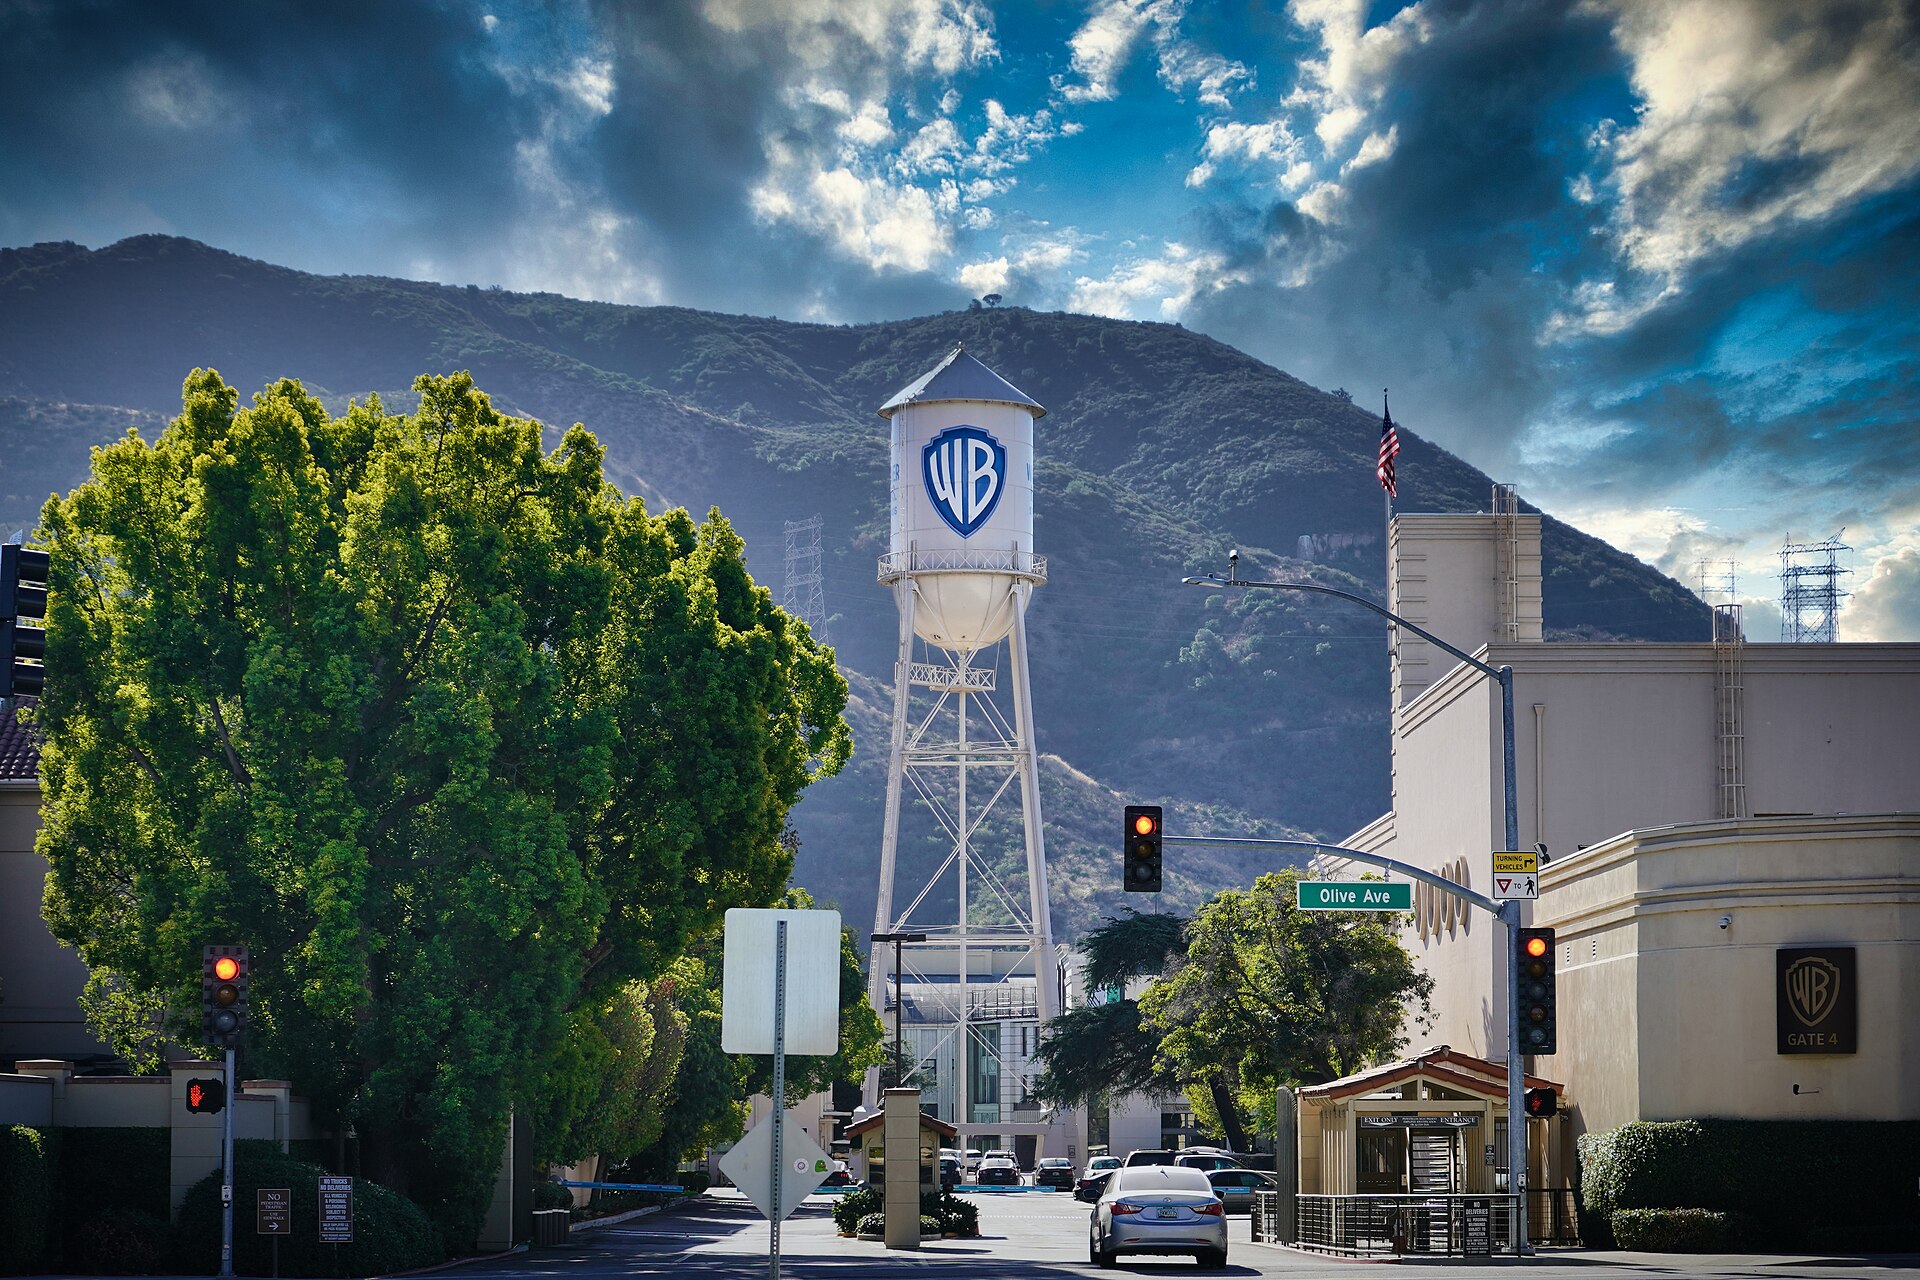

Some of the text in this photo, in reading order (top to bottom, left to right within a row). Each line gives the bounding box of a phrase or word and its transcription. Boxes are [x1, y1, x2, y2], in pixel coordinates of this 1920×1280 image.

[929, 438, 998, 525] WB
[1320, 888, 1391, 904] Olive Ave
[1792, 966, 1830, 1015] WB
[1788, 1033, 1838, 1046] GATE 4
[267, 1193, 281, 1201] NO
